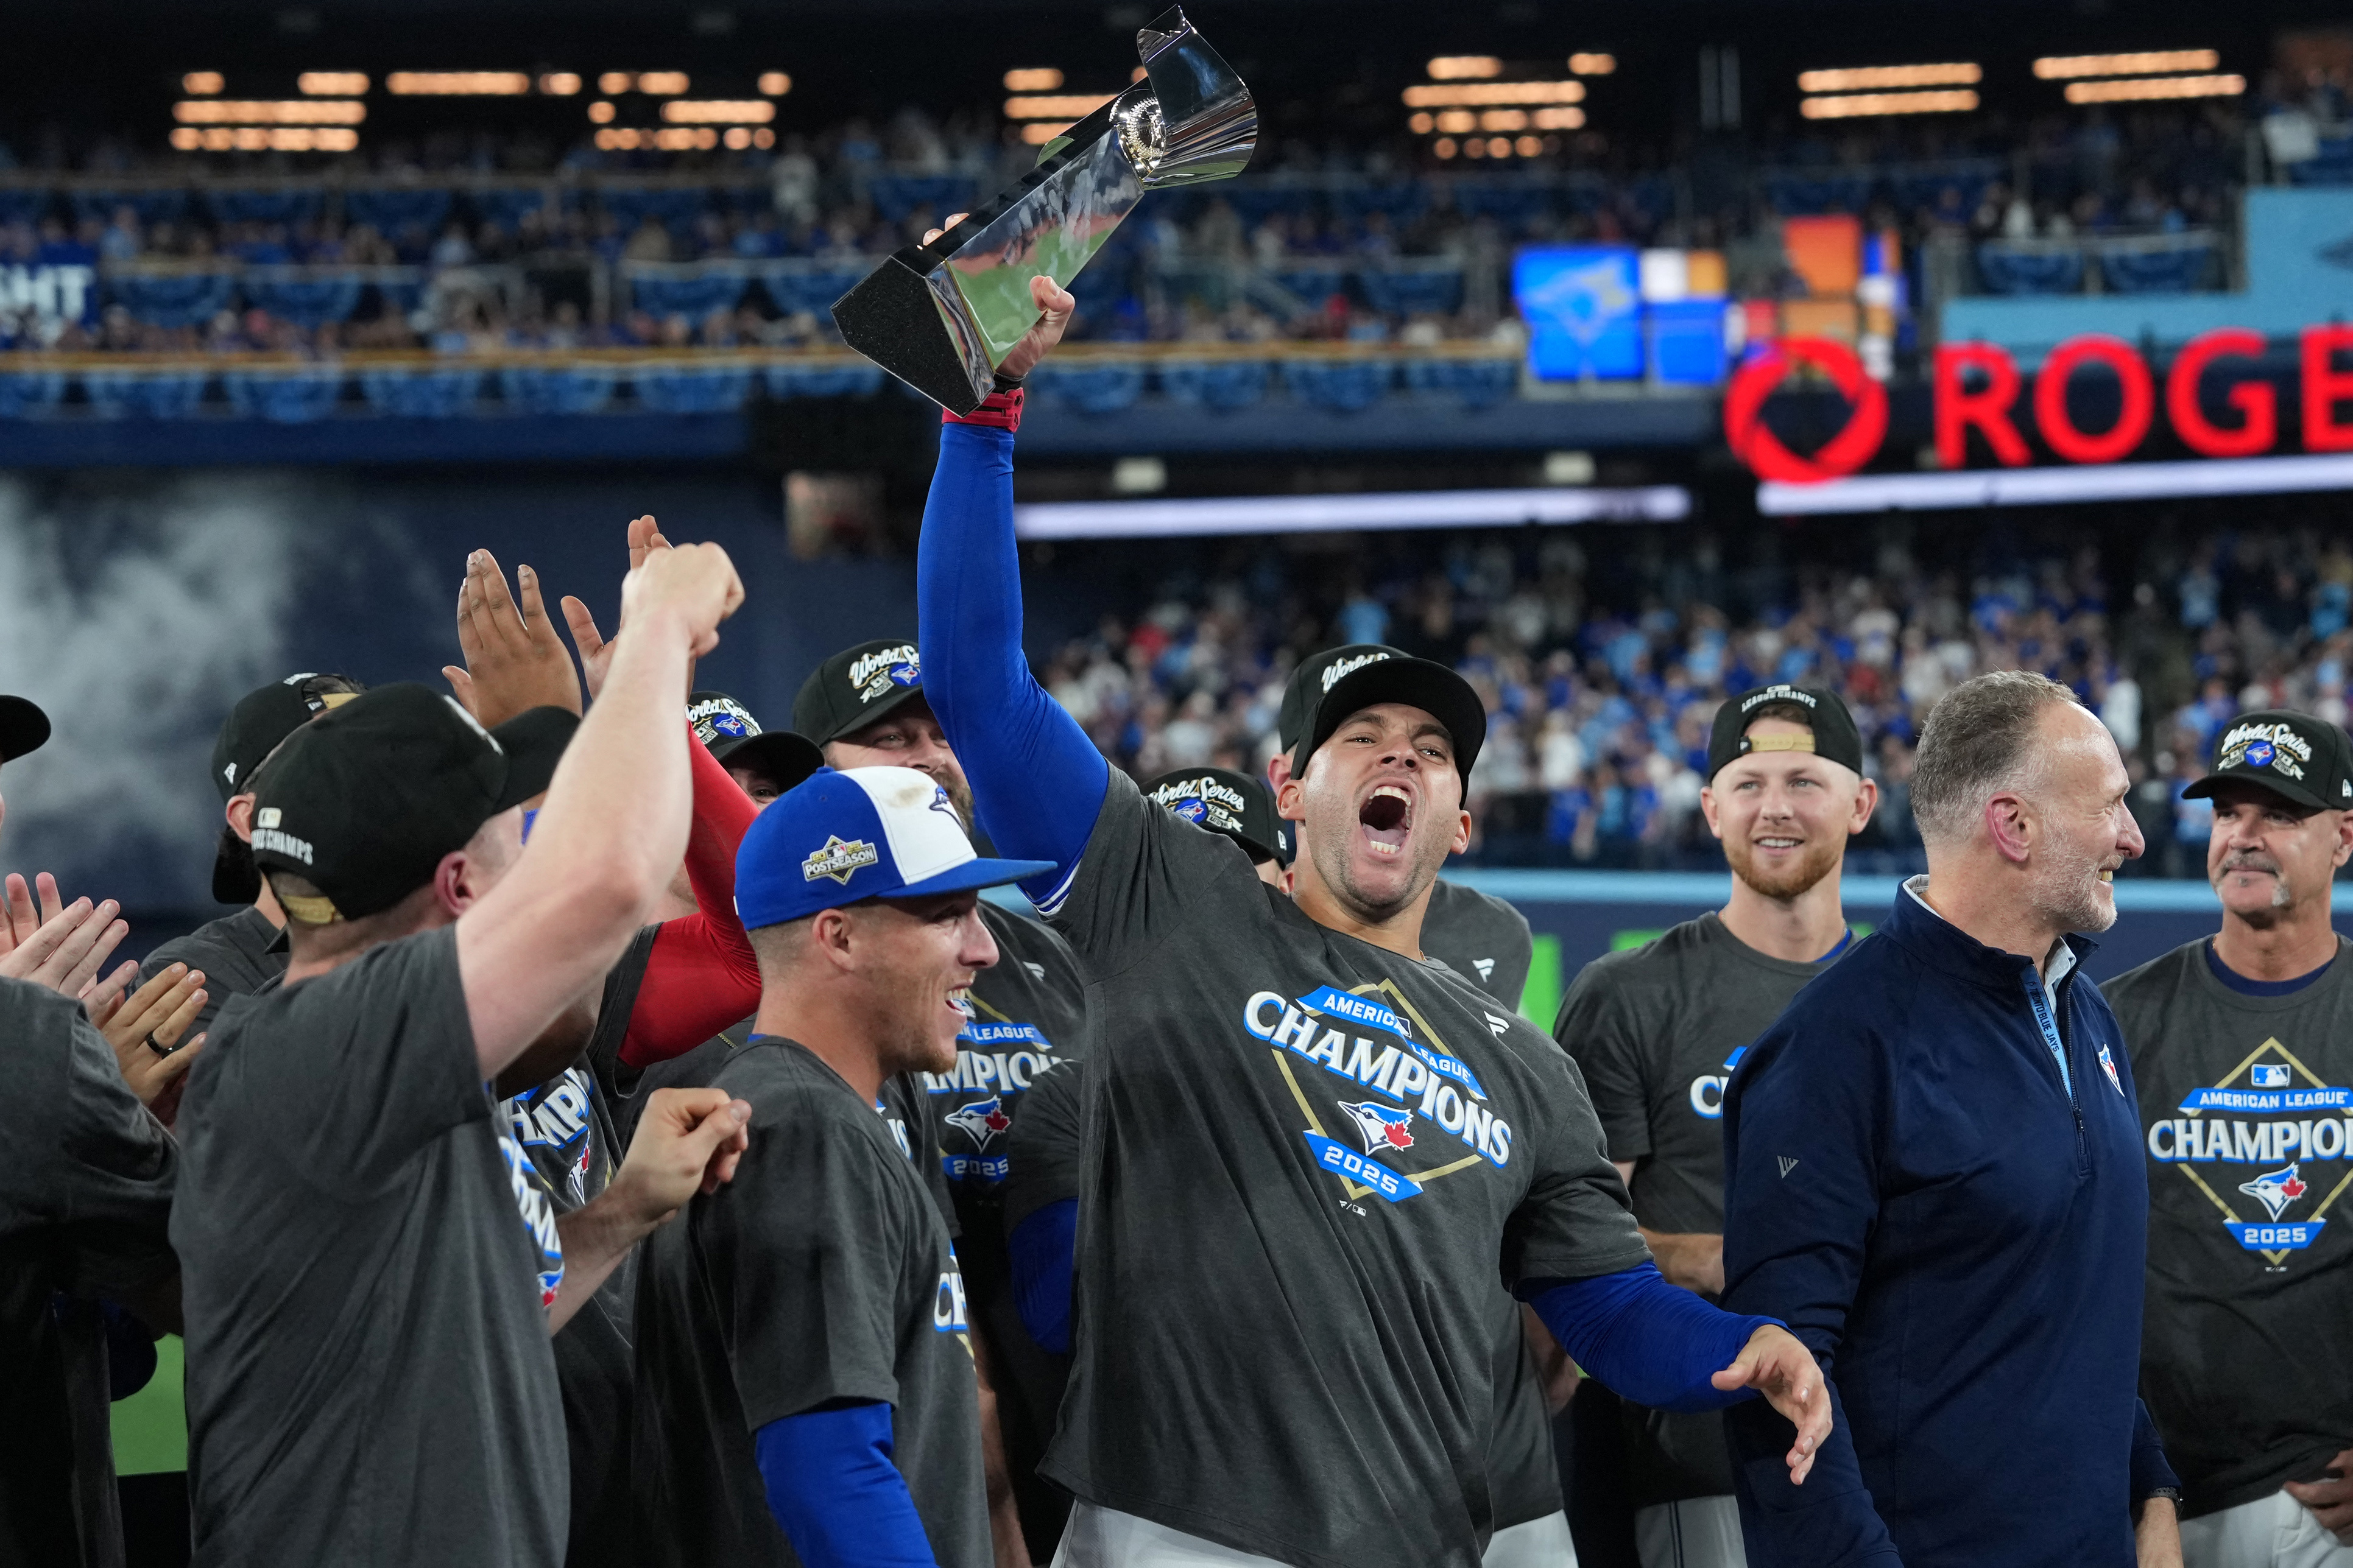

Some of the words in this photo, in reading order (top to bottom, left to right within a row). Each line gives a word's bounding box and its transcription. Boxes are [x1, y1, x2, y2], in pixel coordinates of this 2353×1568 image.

[2221, 723, 2273, 755] World
[2271, 723, 2312, 762] Series
[1200, 776, 1244, 811] Series
[805, 848, 875, 876] POSTSEASON
[973, 1027, 1035, 1041] LEAGUE
[2028, 988, 2045, 1013] TORONTO
[2037, 1012, 2052, 1032] BLUE
[2046, 1033, 2059, 1052] JAYS
[1243, 991, 1512, 1168] CHAMPIONS
[1411, 1043, 1471, 1083] LEAGUE
[2200, 1092, 2279, 1108] AMERICAN
[2285, 1091, 2346, 1107] LEAGUE
[2148, 1118, 2353, 1164] CHAMPIO
[953, 1159, 1009, 1176] 2025
[1323, 1145, 1400, 1195] 2025
[2244, 1226, 2307, 1244] 2025
